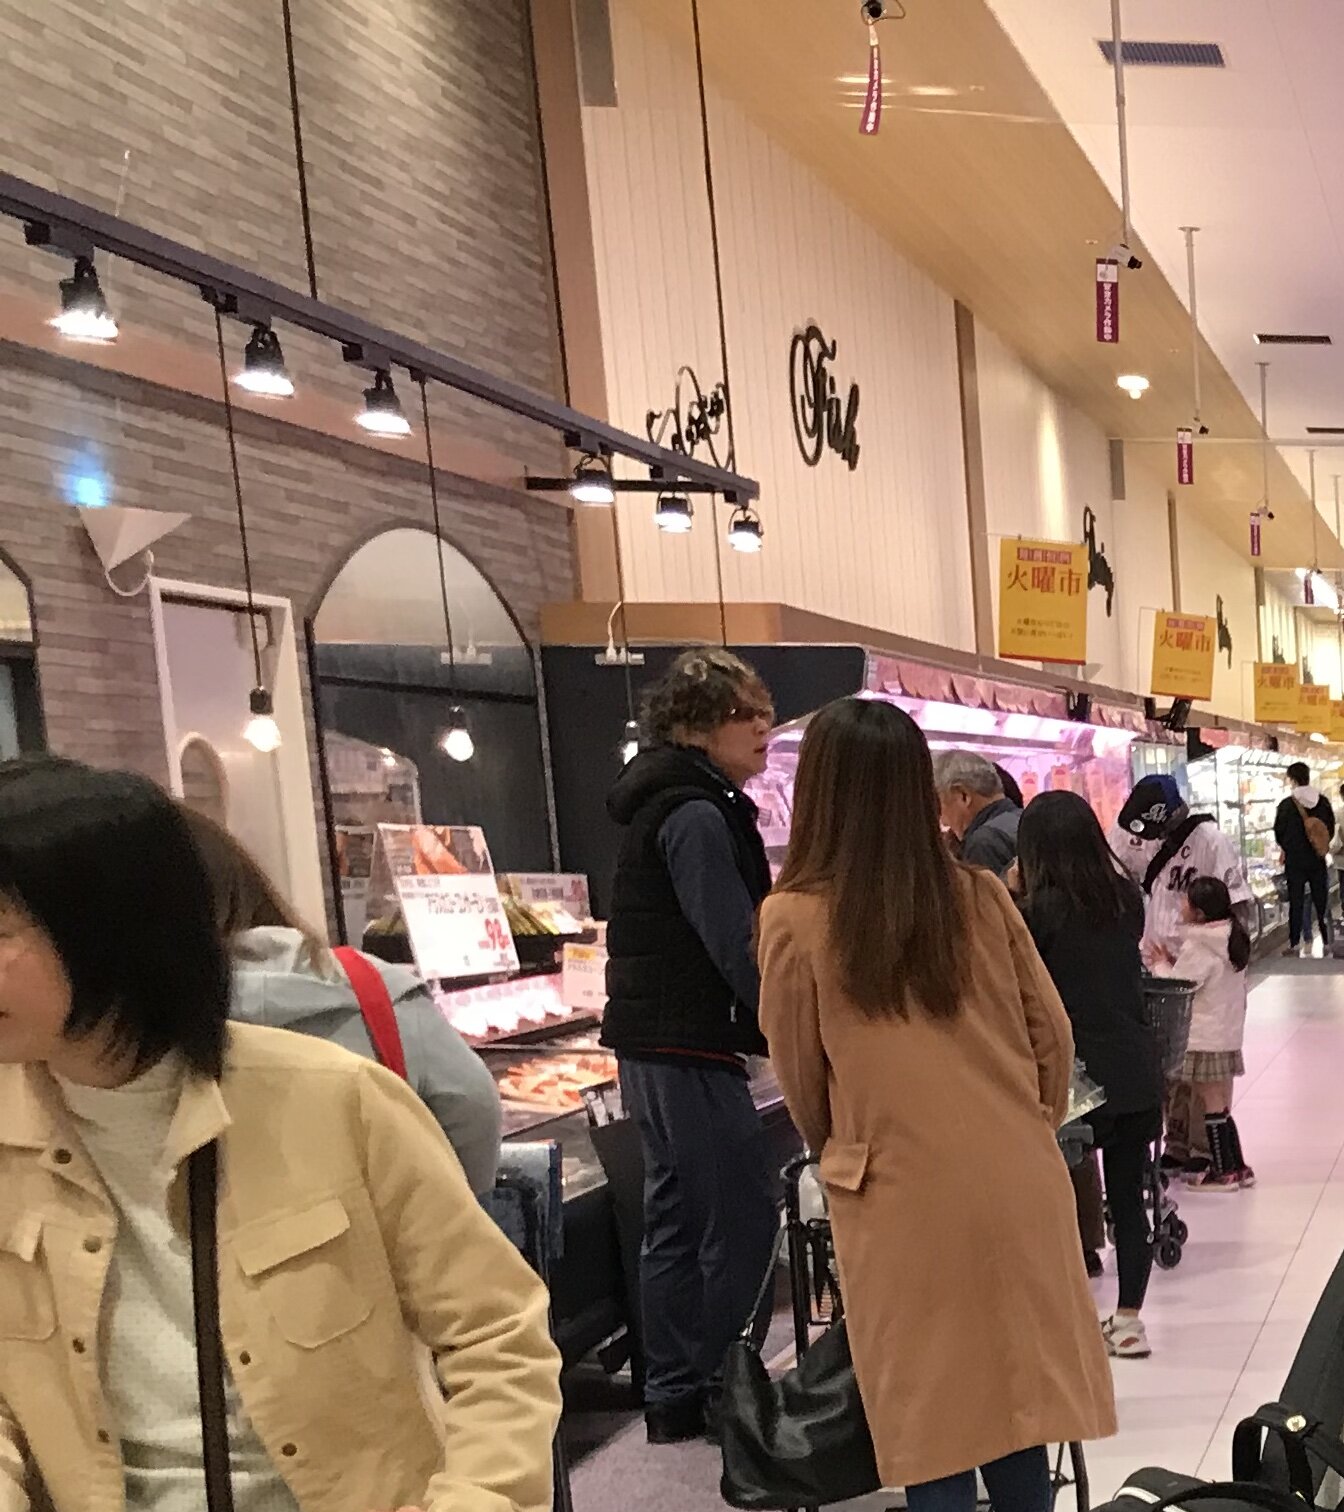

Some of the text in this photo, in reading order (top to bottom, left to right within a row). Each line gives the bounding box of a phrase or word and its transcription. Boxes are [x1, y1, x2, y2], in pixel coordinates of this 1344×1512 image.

[1007, 564, 1083, 597] 火曜市
[1159, 630, 1212, 653] 火曜市
